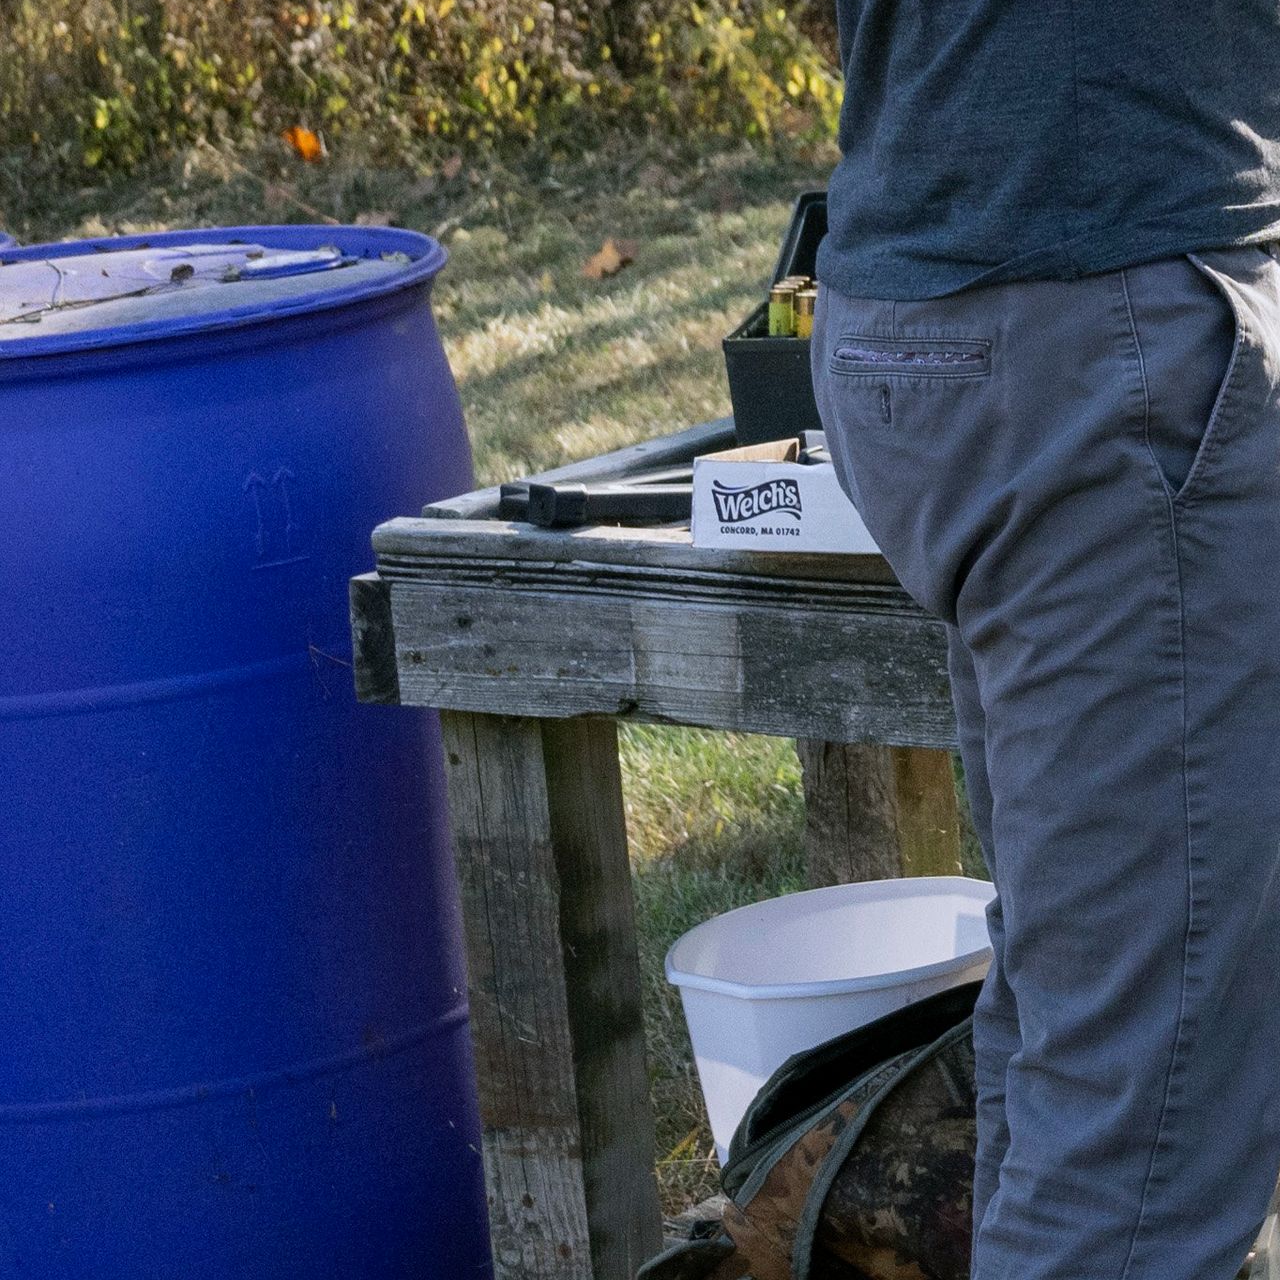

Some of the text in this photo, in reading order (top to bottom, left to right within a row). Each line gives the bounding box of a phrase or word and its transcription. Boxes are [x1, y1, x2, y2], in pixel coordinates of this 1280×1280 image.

[715, 481, 798, 521] Welch's
[720, 526, 759, 536] CONCORD,
[776, 528, 800, 536] 01742
